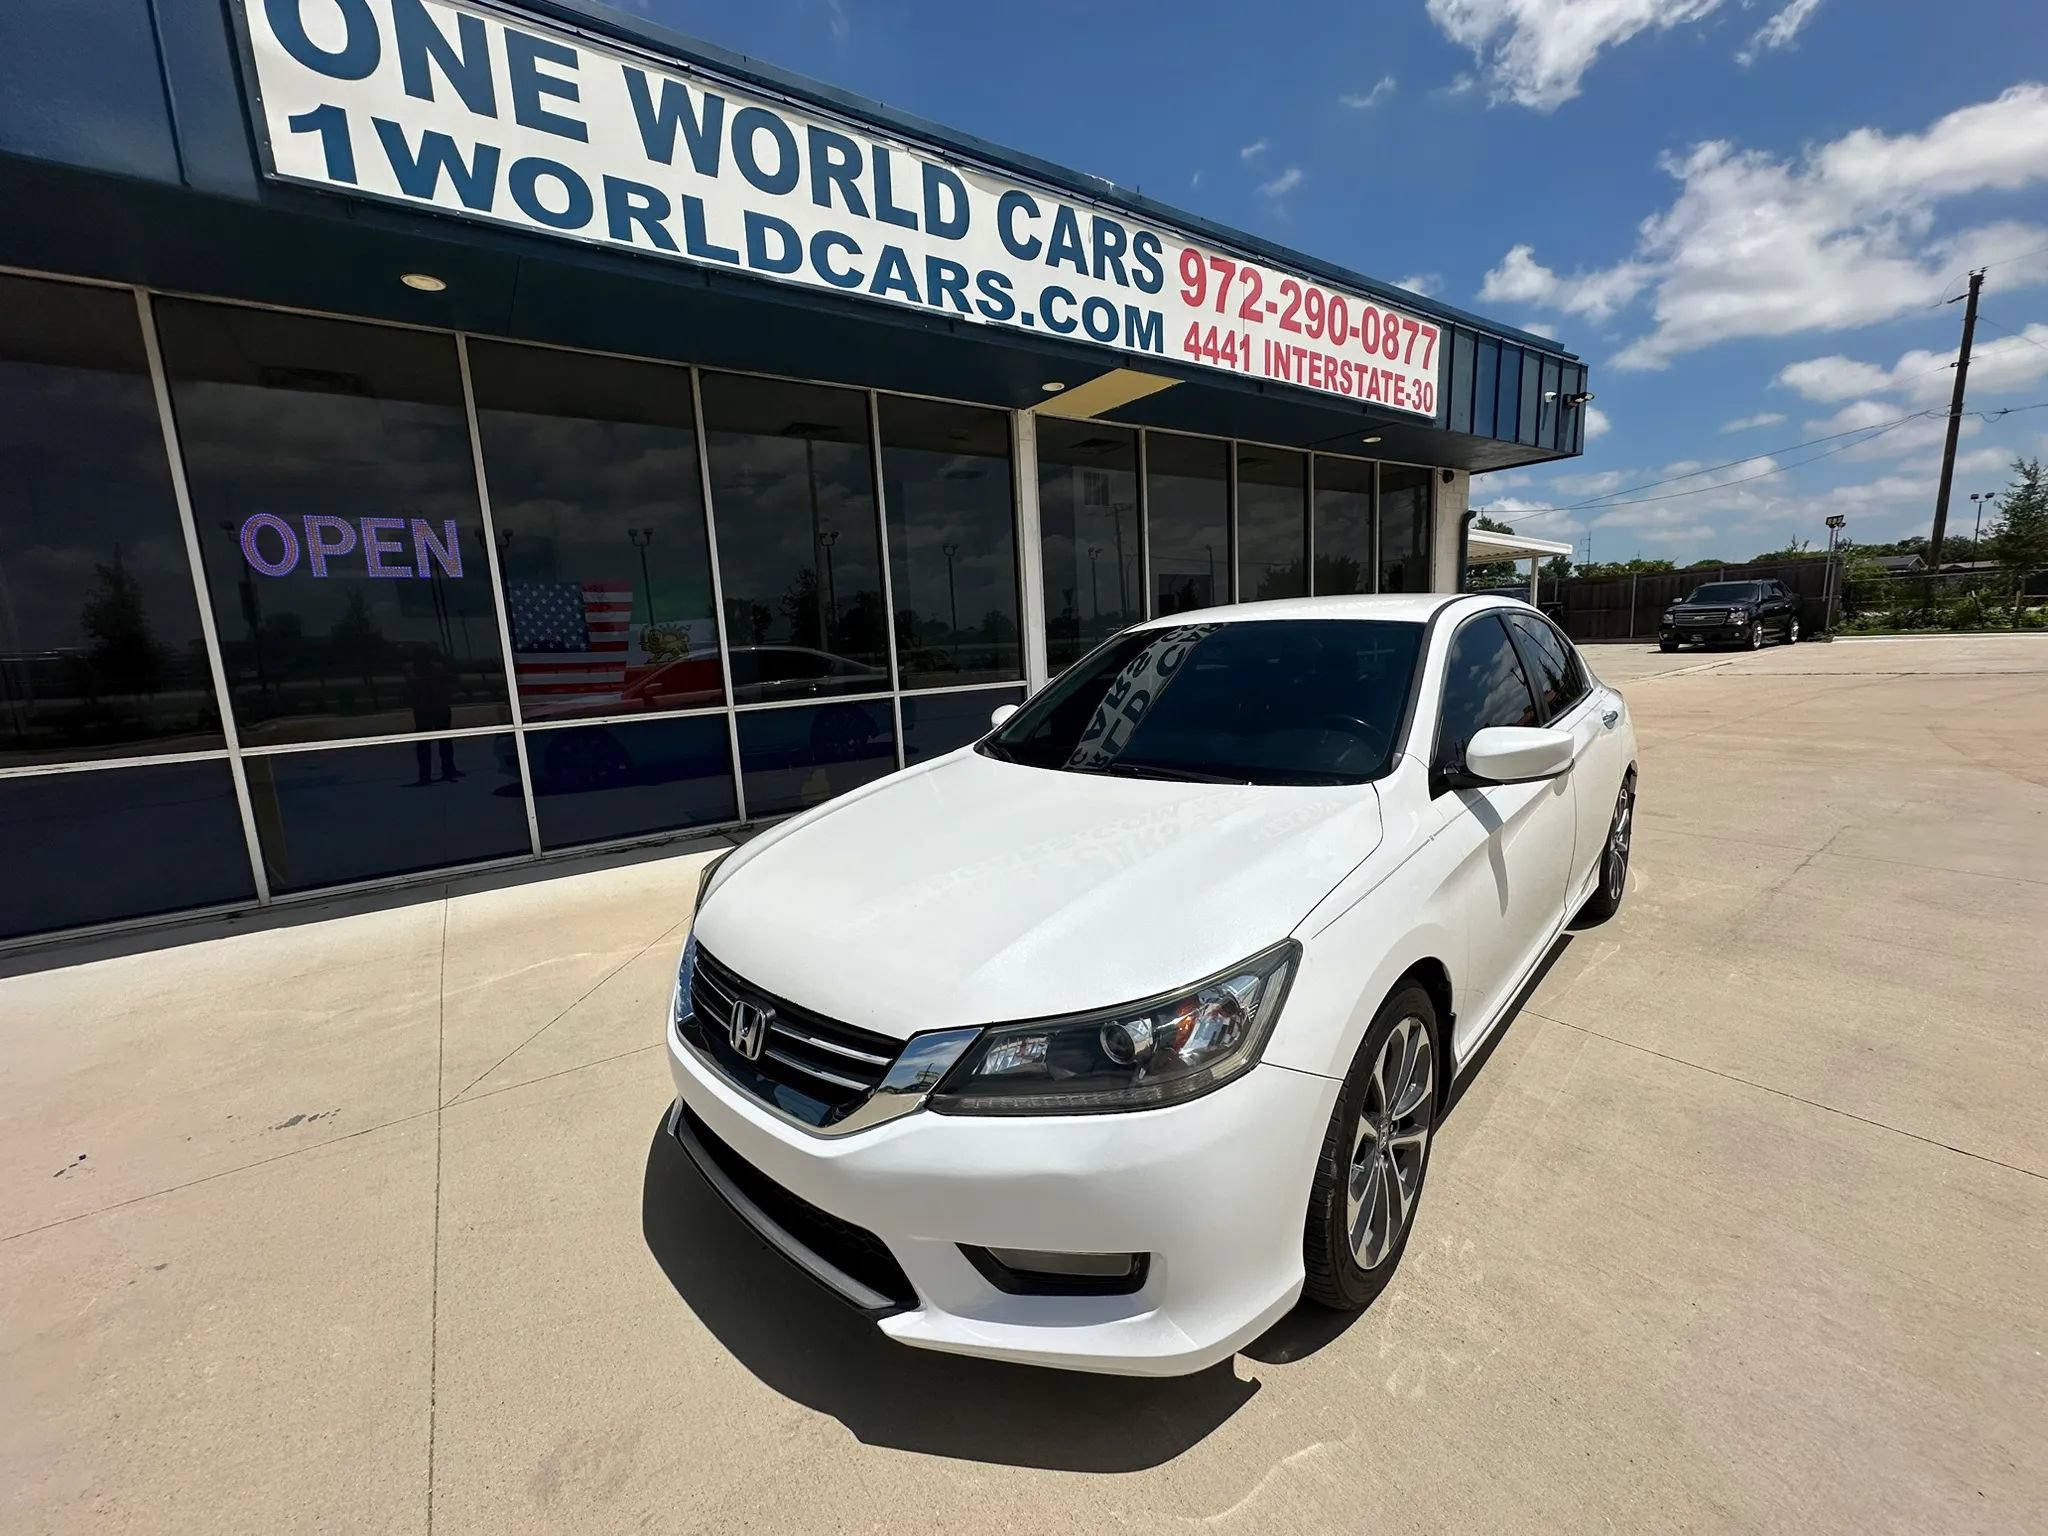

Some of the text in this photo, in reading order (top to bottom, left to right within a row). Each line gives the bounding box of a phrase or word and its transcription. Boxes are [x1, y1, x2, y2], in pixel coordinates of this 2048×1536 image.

[264, 0, 1164, 295] ONE WORLD CARS
[288, 104, 1164, 355] 1WORLDCARS.COM
[1179, 248, 1438, 369] 972-290-0877
[1183, 322, 1434, 412] 4441 INTERSTATE-30
[240, 513, 464, 578] OPEN
